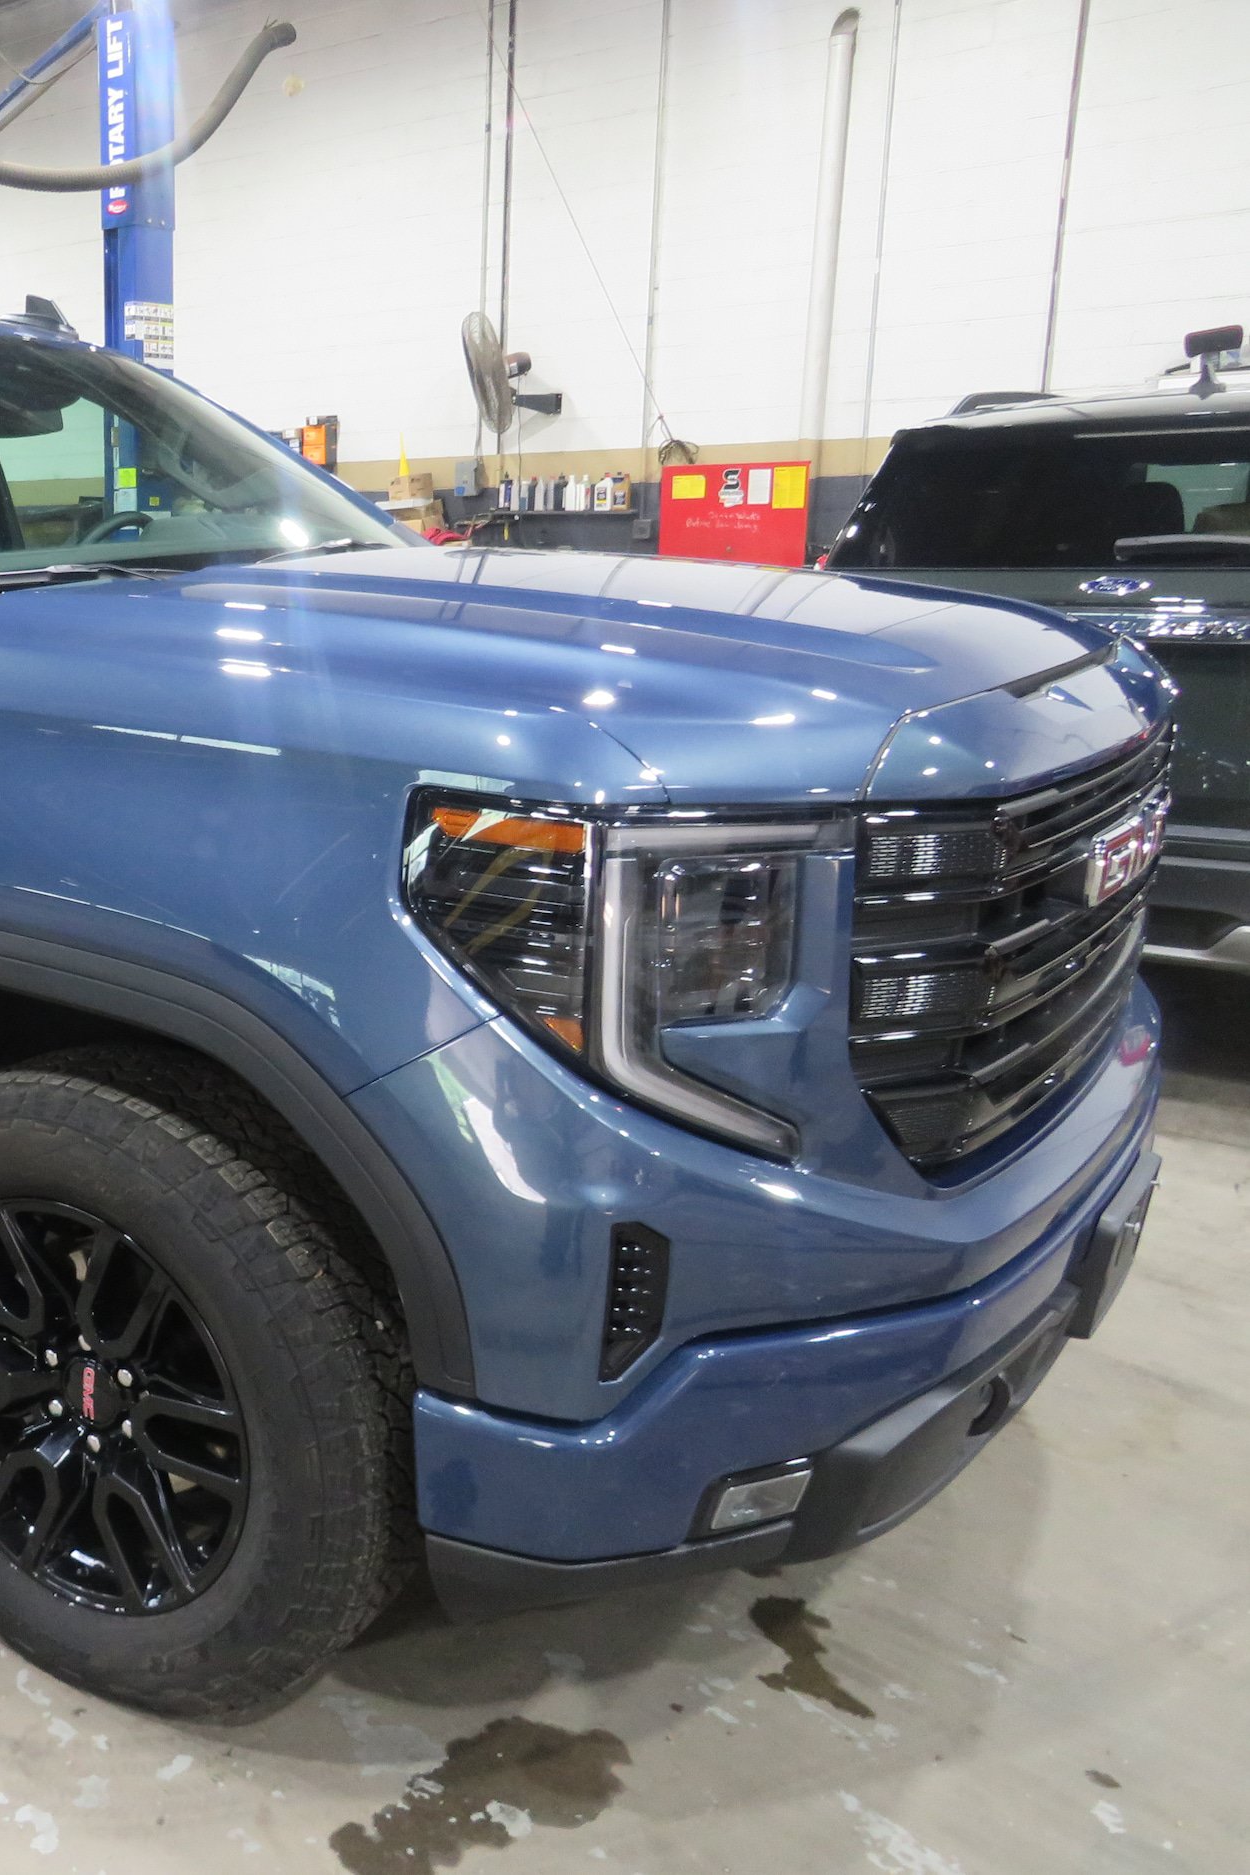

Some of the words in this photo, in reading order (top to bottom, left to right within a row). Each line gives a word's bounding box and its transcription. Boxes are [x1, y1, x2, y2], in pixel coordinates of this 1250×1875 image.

[106, 19, 124, 80] LIFT
[107, 87, 126, 199] RTARY
[82, 1366, 95, 1420] GMC
